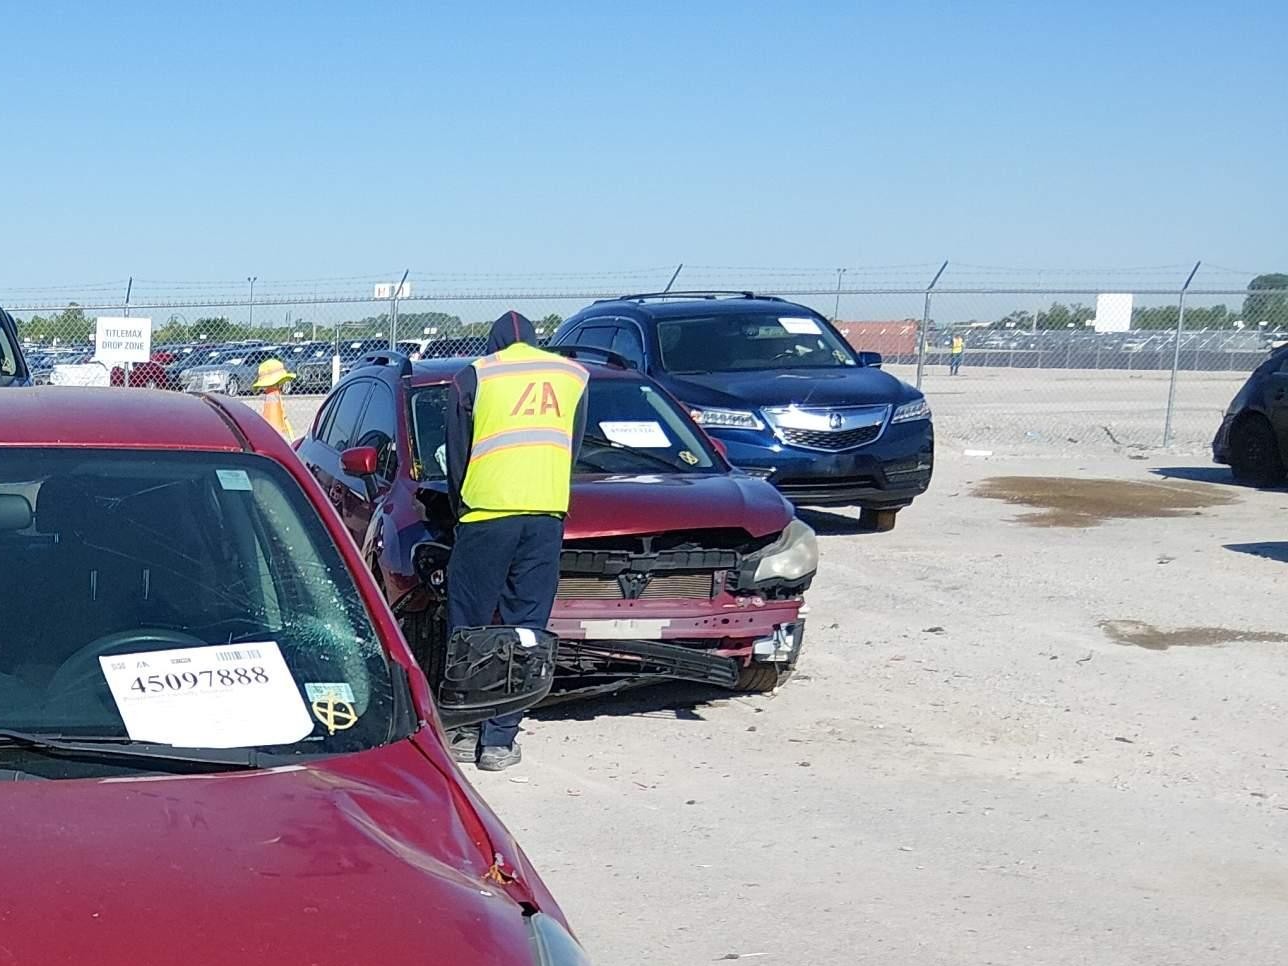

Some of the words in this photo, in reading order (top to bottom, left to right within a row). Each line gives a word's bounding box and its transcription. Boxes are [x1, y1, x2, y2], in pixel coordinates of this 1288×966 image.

[105, 328, 142, 338] TITLEMAX
[102, 340, 122, 349] DROP
[124, 341, 144, 350] ZONE
[130, 666, 269, 694] 45097888
